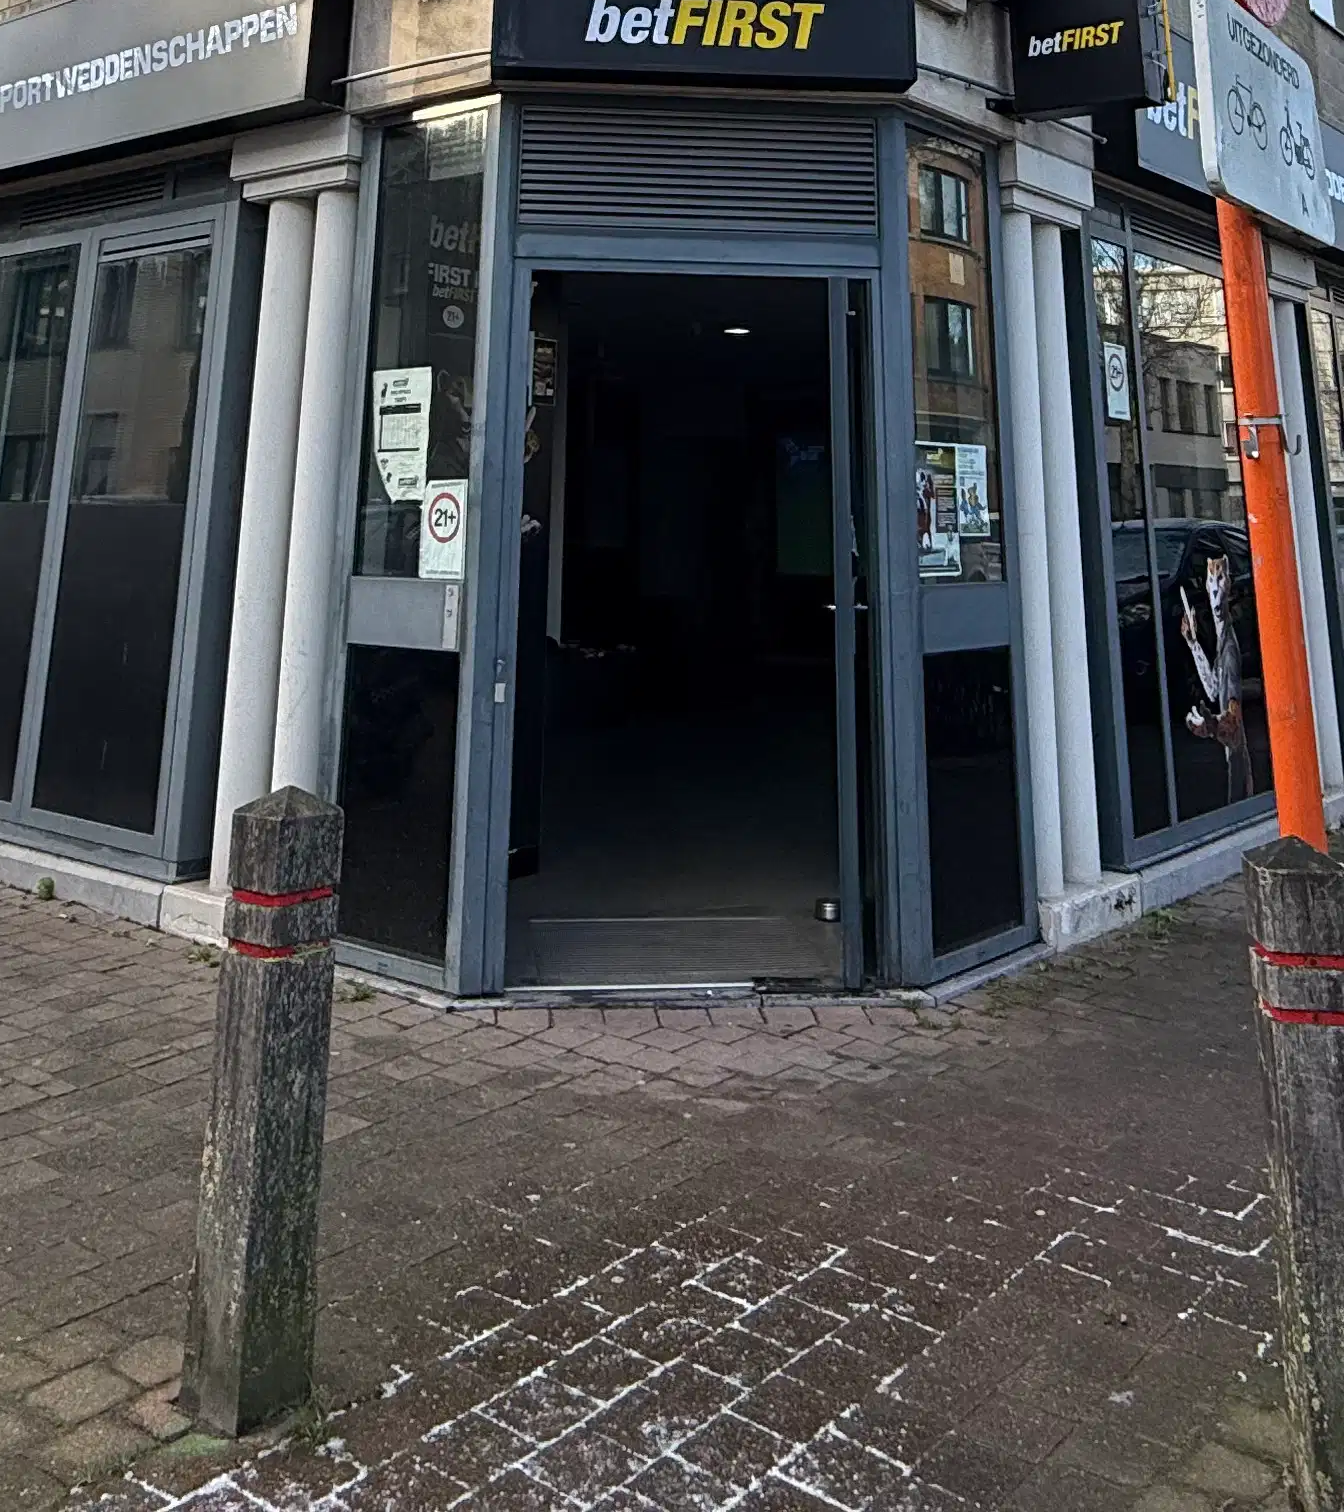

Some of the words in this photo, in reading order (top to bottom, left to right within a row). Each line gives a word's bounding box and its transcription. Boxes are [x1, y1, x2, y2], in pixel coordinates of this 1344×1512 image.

[1028, 21, 1124, 57] betFIRST
[1227, 12, 1300, 90] UITGEZONDERD
[434, 508, 456, 527] 21+
